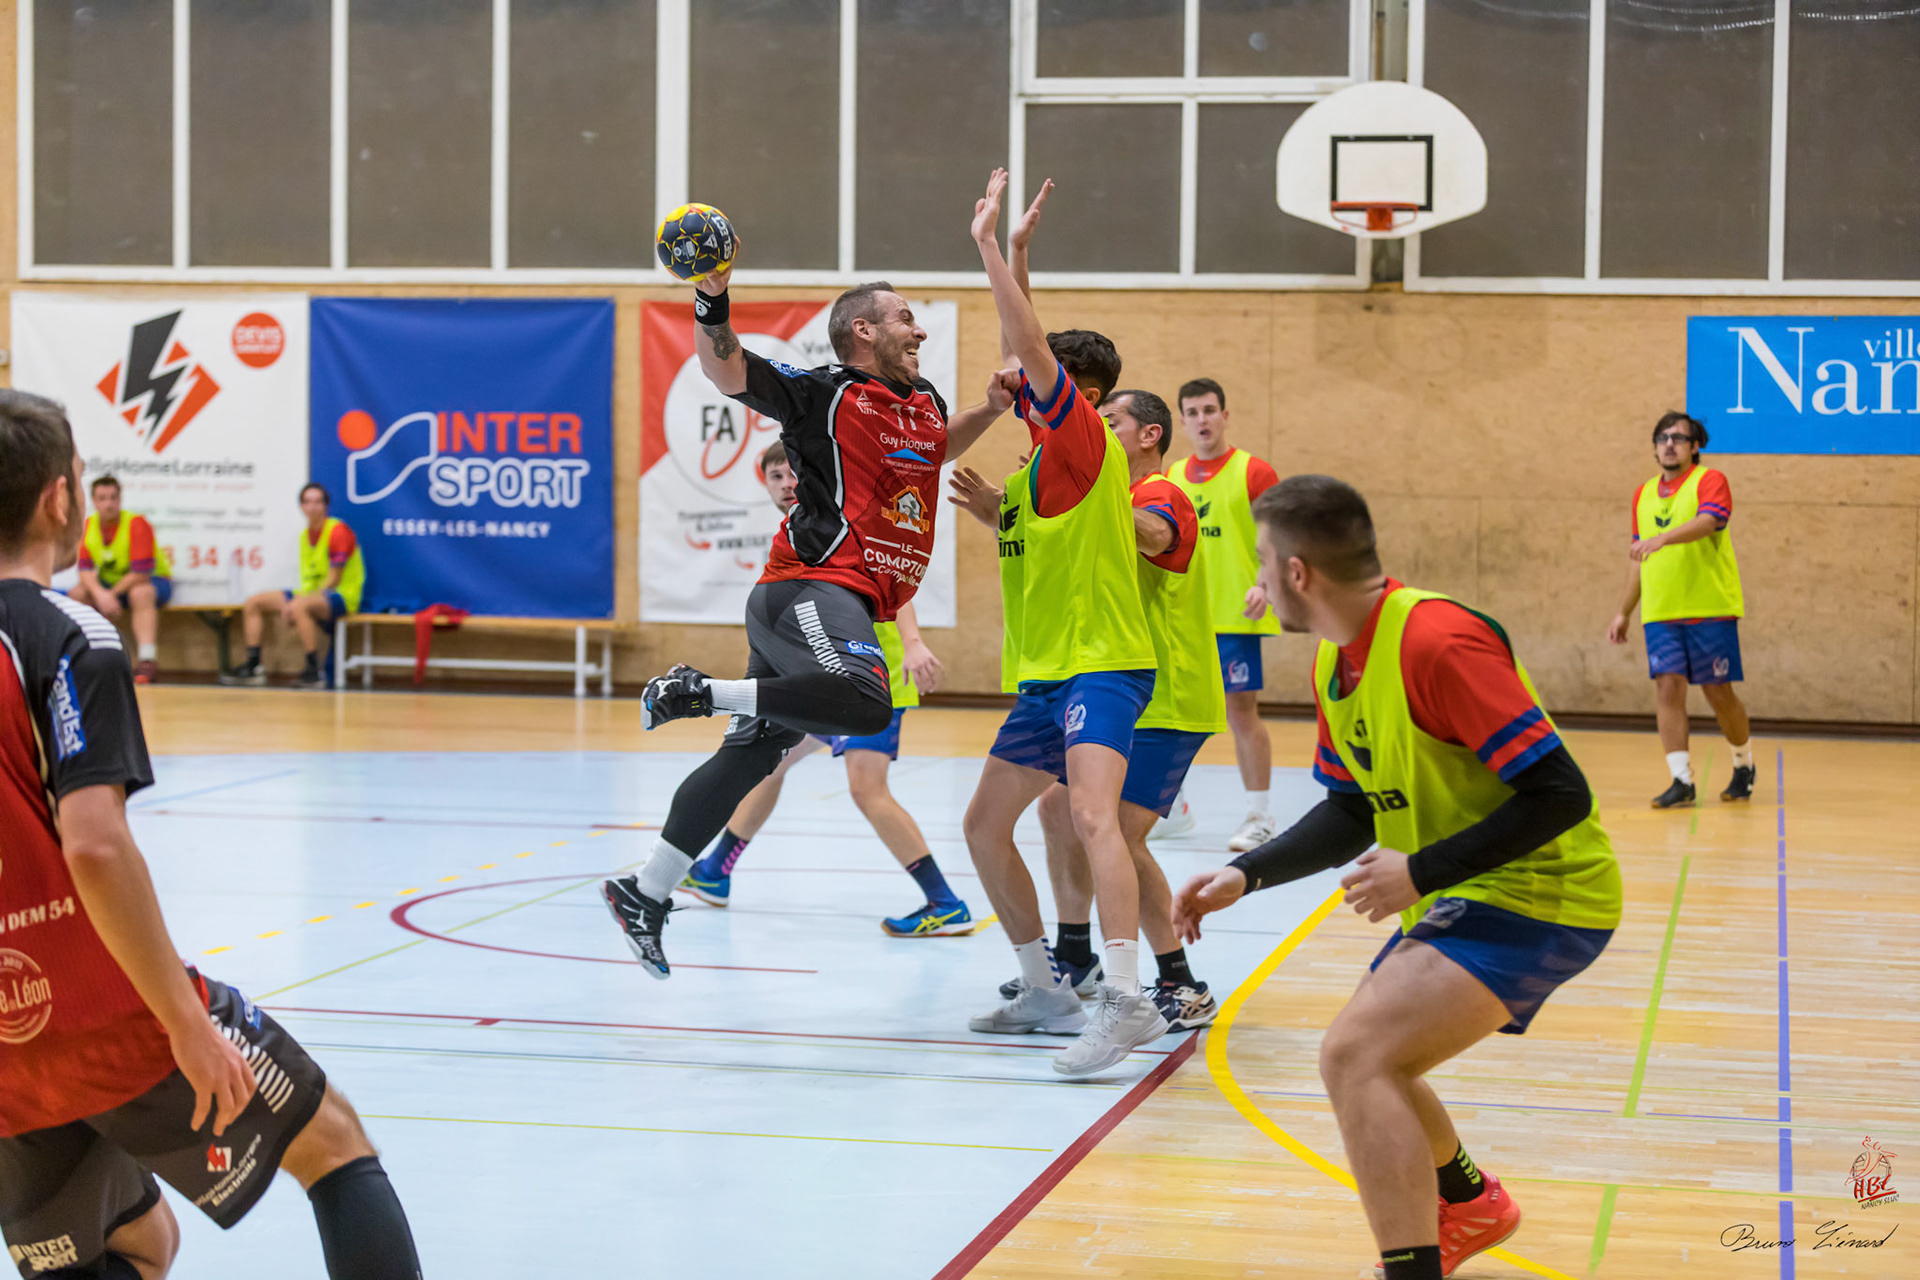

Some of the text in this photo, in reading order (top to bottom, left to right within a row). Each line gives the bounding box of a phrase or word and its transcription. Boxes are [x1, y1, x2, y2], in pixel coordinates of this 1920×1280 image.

[711, 215, 733, 260] SELECT
[1863, 328, 1920, 359] vill
[437, 411, 582, 453] INTER
[880, 432, 936, 452] Guy Hoquet
[429, 456, 591, 508] SPORT
[383, 518, 550, 538] ESSEY-LES-NANCY
[188, 545, 219, 570] 34
[901, 543, 913, 555] LE
[8, 904, 46, 931] DEM
[50, 896, 75, 920] 54
[11, 975, 53, 1010] Léon
